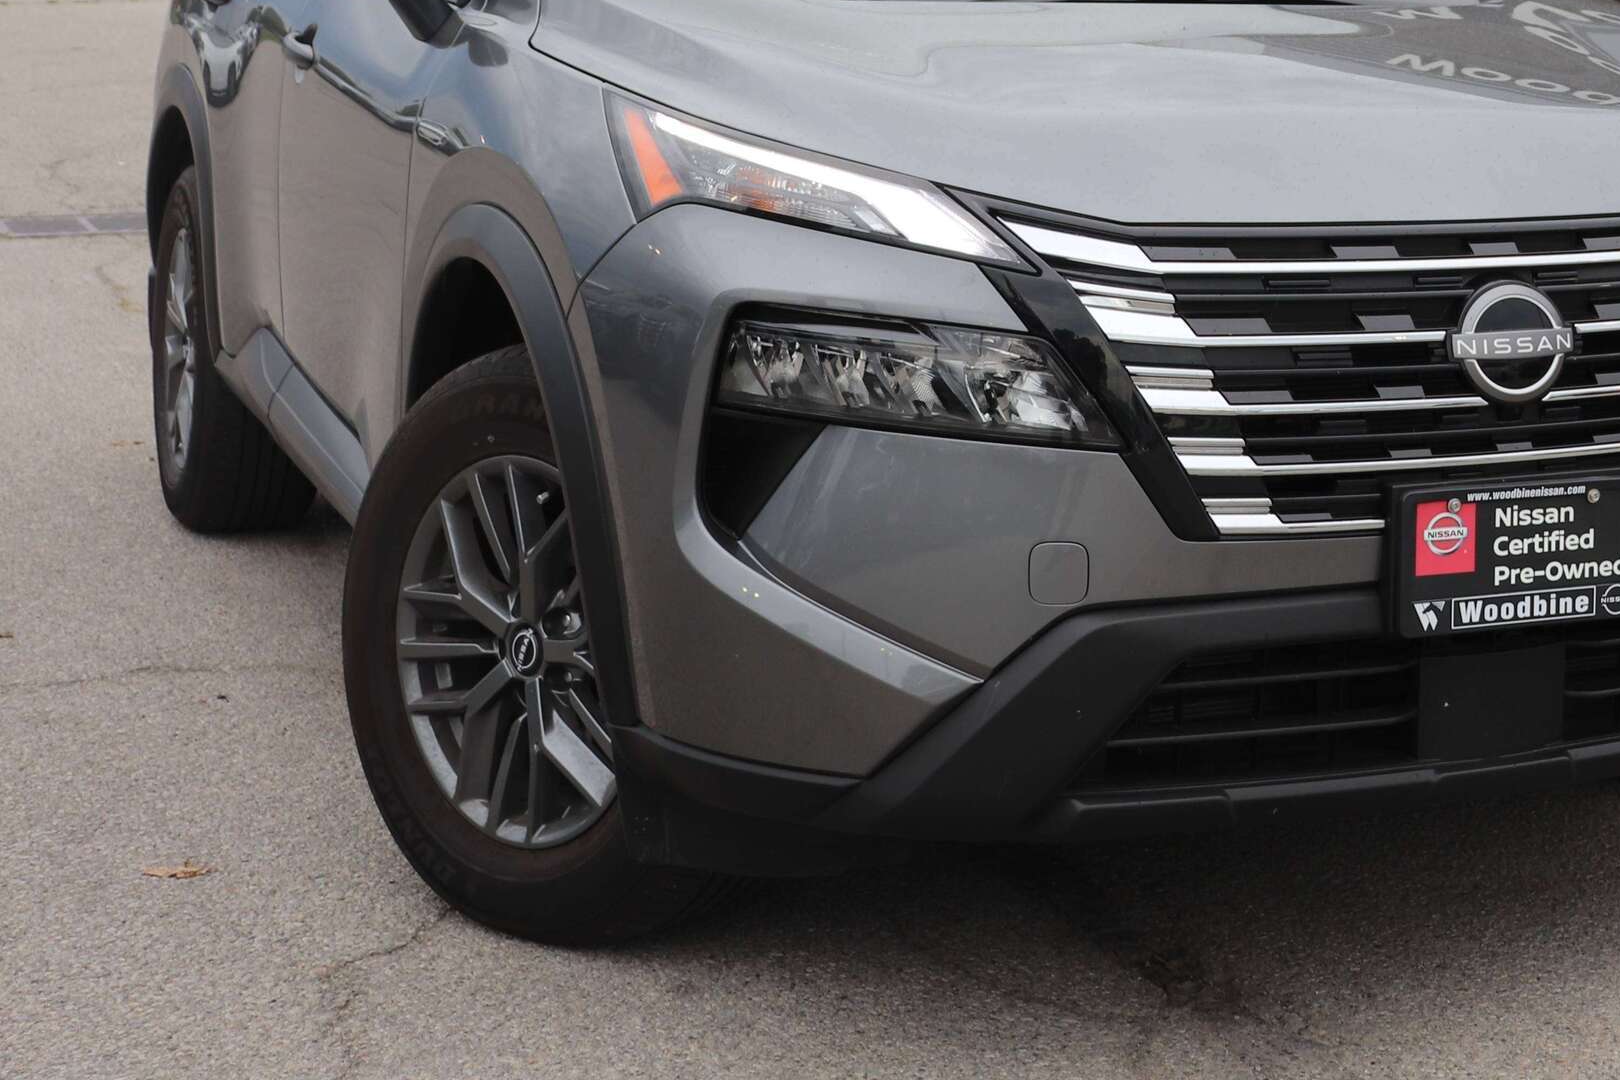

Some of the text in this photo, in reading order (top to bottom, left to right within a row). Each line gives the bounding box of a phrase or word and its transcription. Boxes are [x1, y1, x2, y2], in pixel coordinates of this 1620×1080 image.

[1457, 333, 1572, 355] NISSAN
[1467, 486, 1586, 502] www.woodbinenissan.com
[1495, 505, 1575, 528] Nissan
[1427, 528, 1465, 539] NISSAN
[1493, 528, 1595, 557] Certified
[1459, 593, 1589, 624] Woodbine
